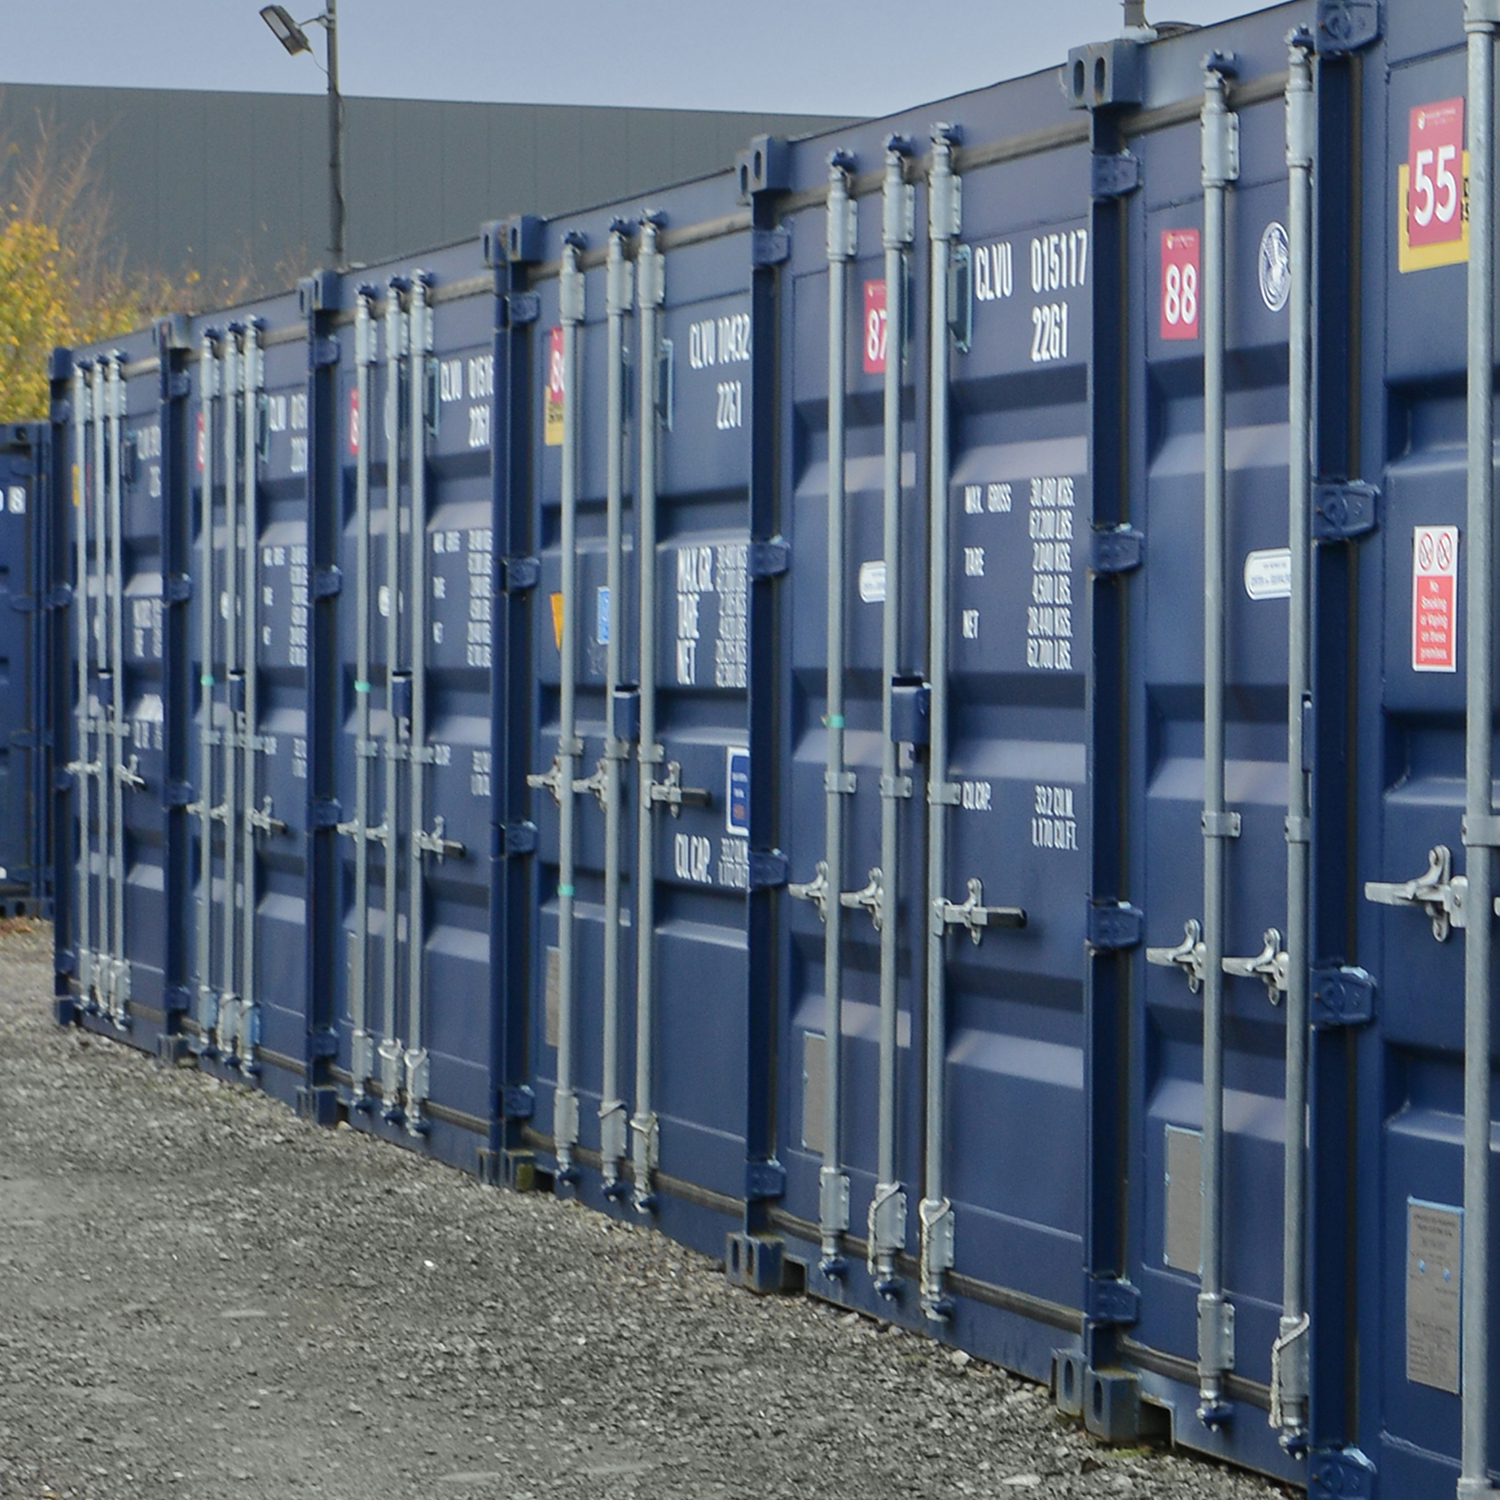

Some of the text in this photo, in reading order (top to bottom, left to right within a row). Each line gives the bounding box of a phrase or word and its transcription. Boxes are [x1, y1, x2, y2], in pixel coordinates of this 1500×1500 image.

[1413, 144, 1457, 227] 55
[975, 228, 1087, 301] CLVU 015117
[1165, 262, 1197, 325] 88
